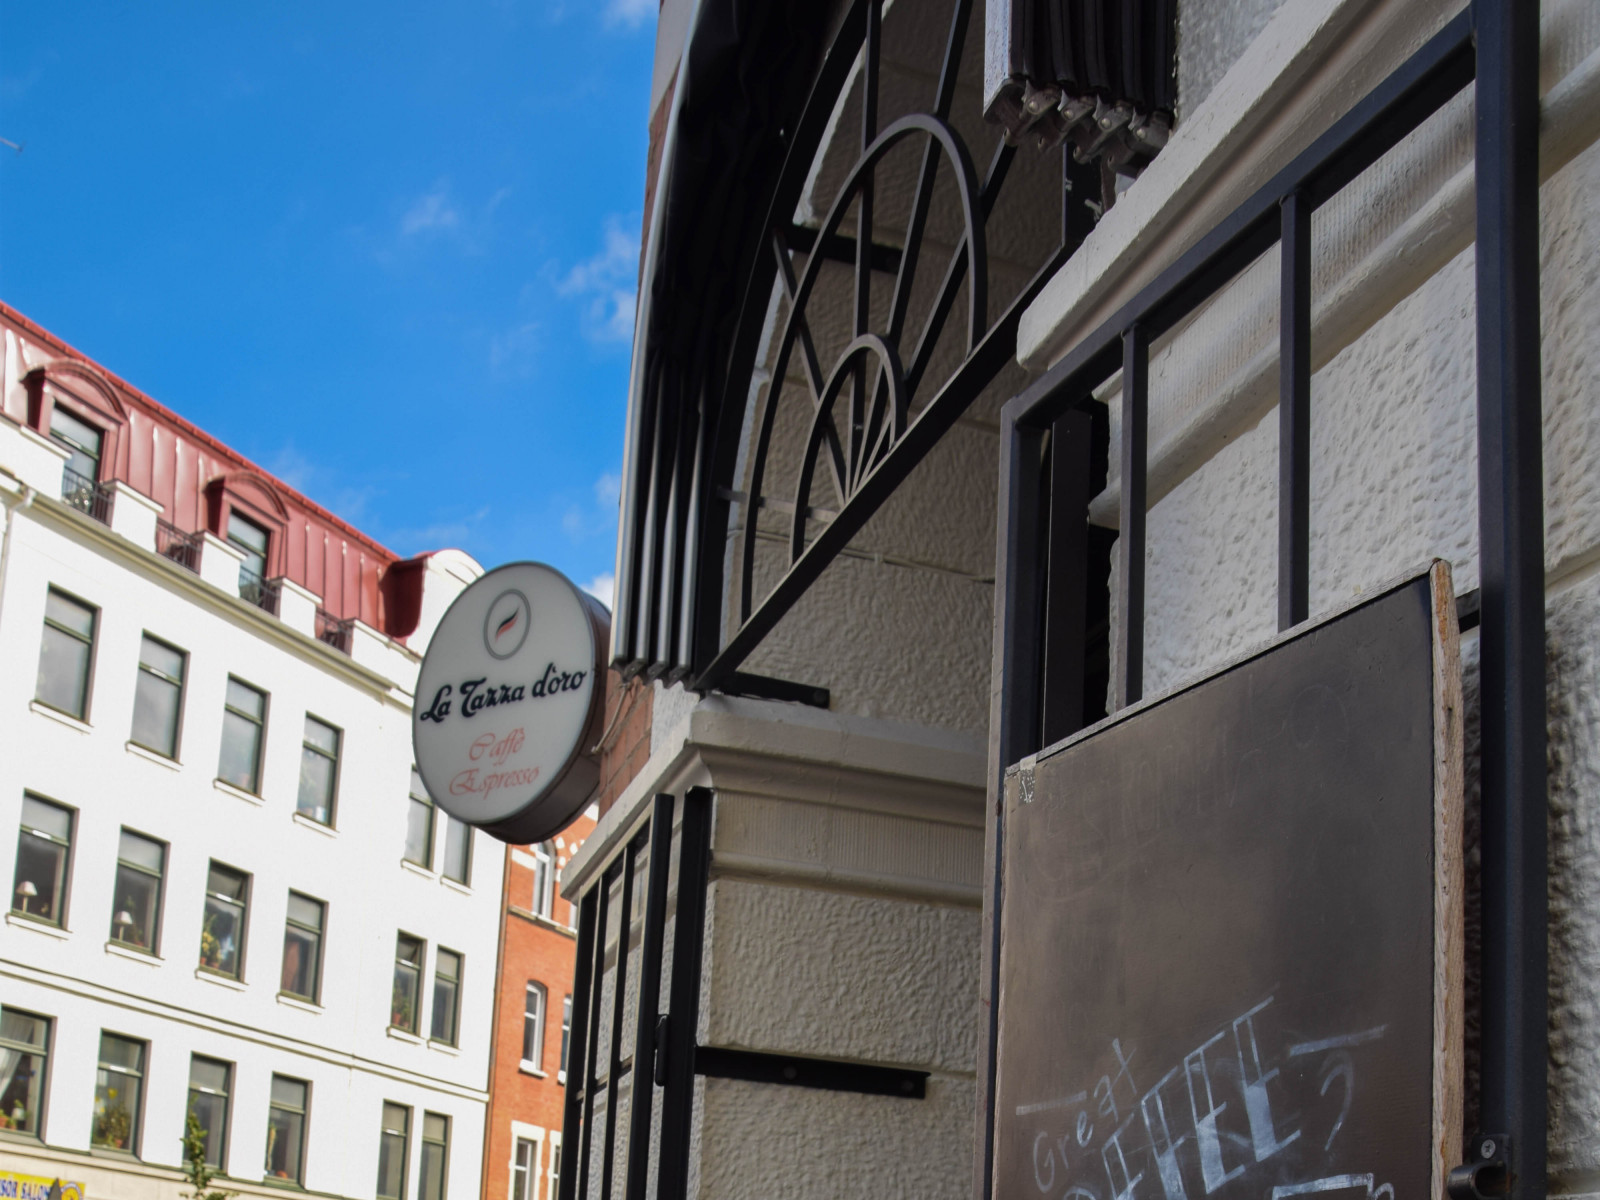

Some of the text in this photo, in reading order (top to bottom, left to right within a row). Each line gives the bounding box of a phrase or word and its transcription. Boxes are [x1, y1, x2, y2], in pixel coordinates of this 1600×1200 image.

[420, 685, 452, 723] La
[460, 677, 525, 718] Tazza
[449, 766, 540, 800] Espresso
[1033, 1038, 1137, 1193] Great
